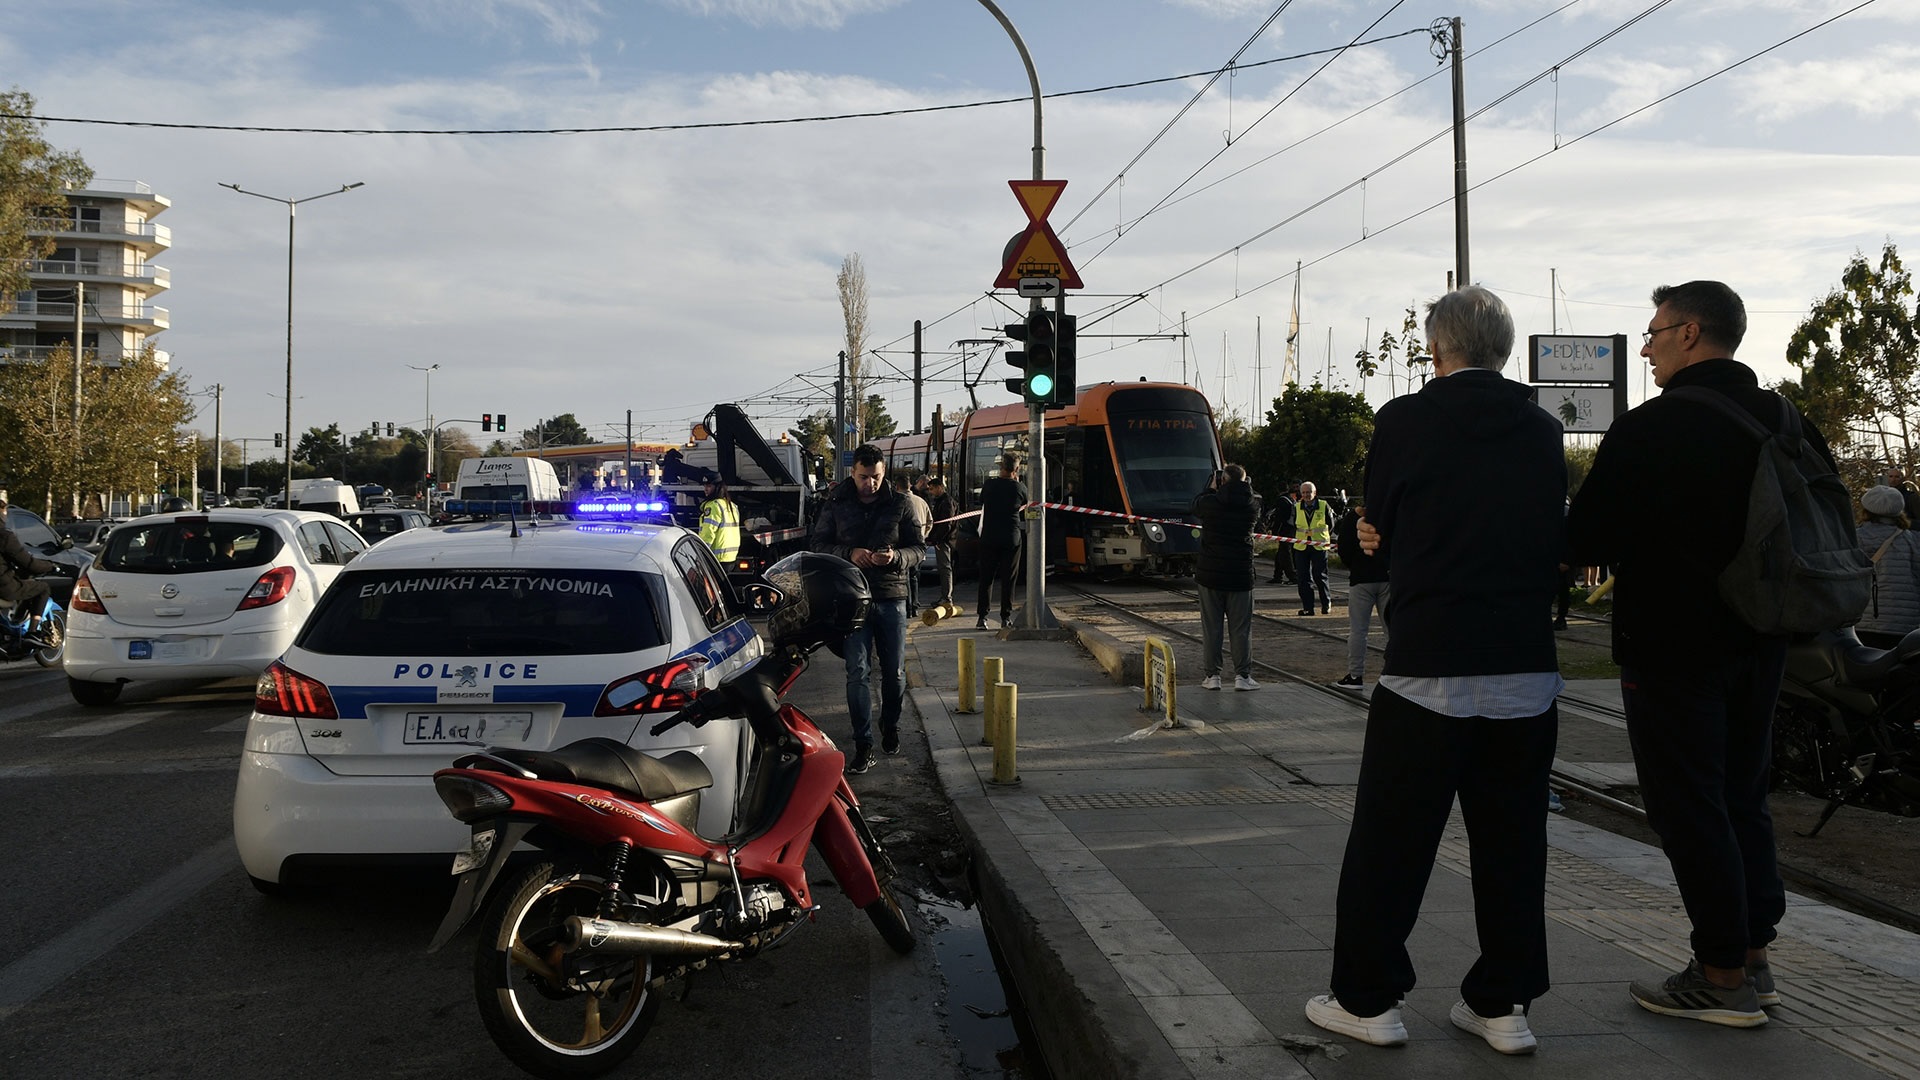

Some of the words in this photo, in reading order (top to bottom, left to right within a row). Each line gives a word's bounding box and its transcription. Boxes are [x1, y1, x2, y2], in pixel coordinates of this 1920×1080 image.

[1553, 343, 1597, 359] EDEM
[1128, 419, 1135, 429] 7
[640, 445, 665, 453] Shell
[359, 576, 476, 598] ΕΛΛΗΝΙΚΗ
[480, 576, 614, 598] ΑΣΤΥΝΟΜΙΑ
[393, 663, 538, 679] POLICE
[311, 730, 342, 738] 308
